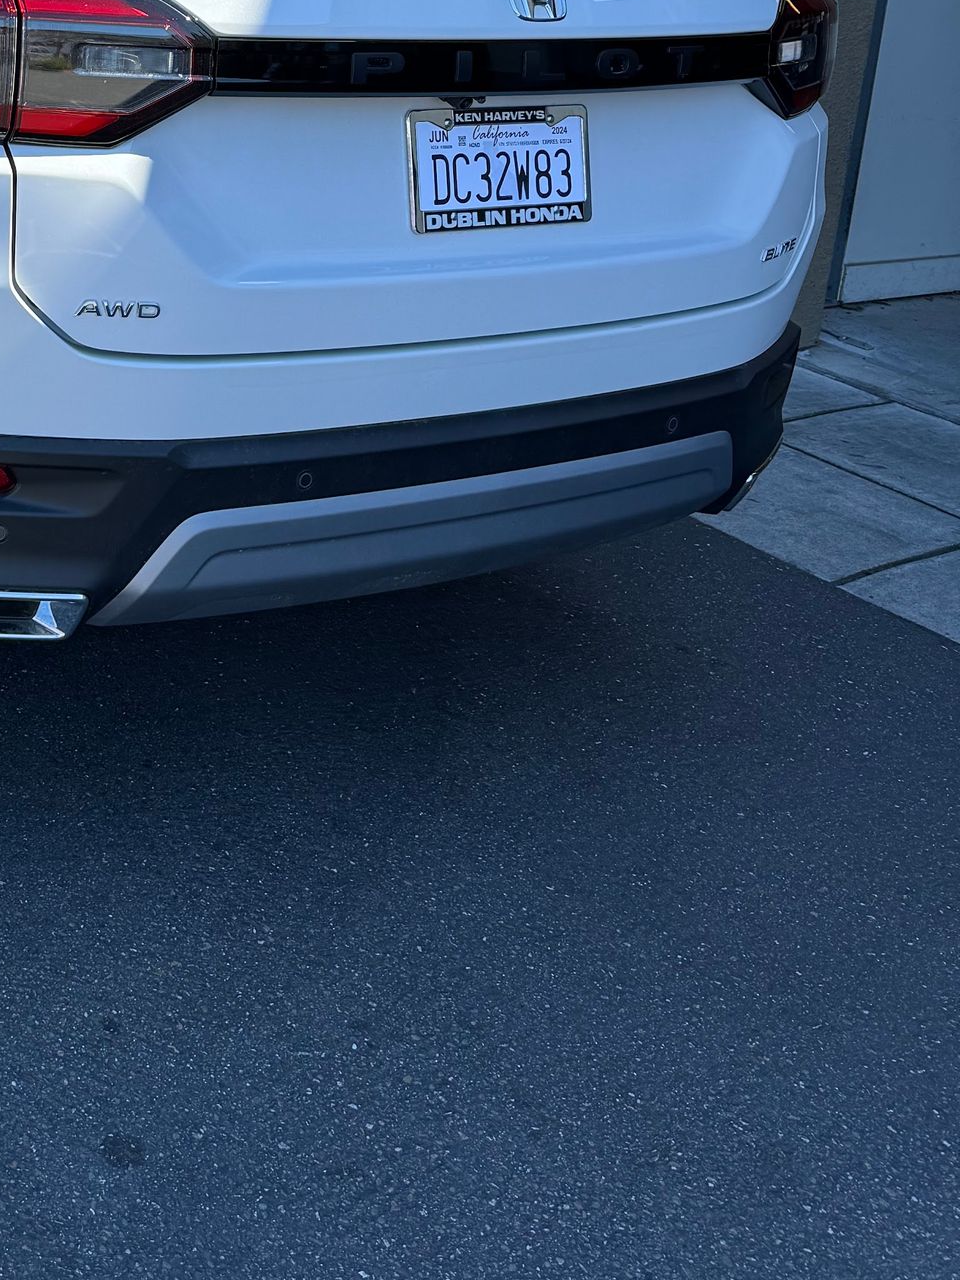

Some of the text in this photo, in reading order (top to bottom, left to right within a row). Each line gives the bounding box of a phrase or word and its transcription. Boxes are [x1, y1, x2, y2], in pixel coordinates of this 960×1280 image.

[350, 46, 705, 85] PILOT
[455, 110, 545, 123] KEN HARVEY'S
[429, 130, 449, 144] JUN
[472, 125, 530, 147] California
[551, 126, 568, 136] 2024
[431, 148, 573, 206] DC32W83
[426, 205, 583, 230] DUBLIN HONDA
[760, 237, 798, 262] ELITE
[74, 299, 161, 319] AWD
